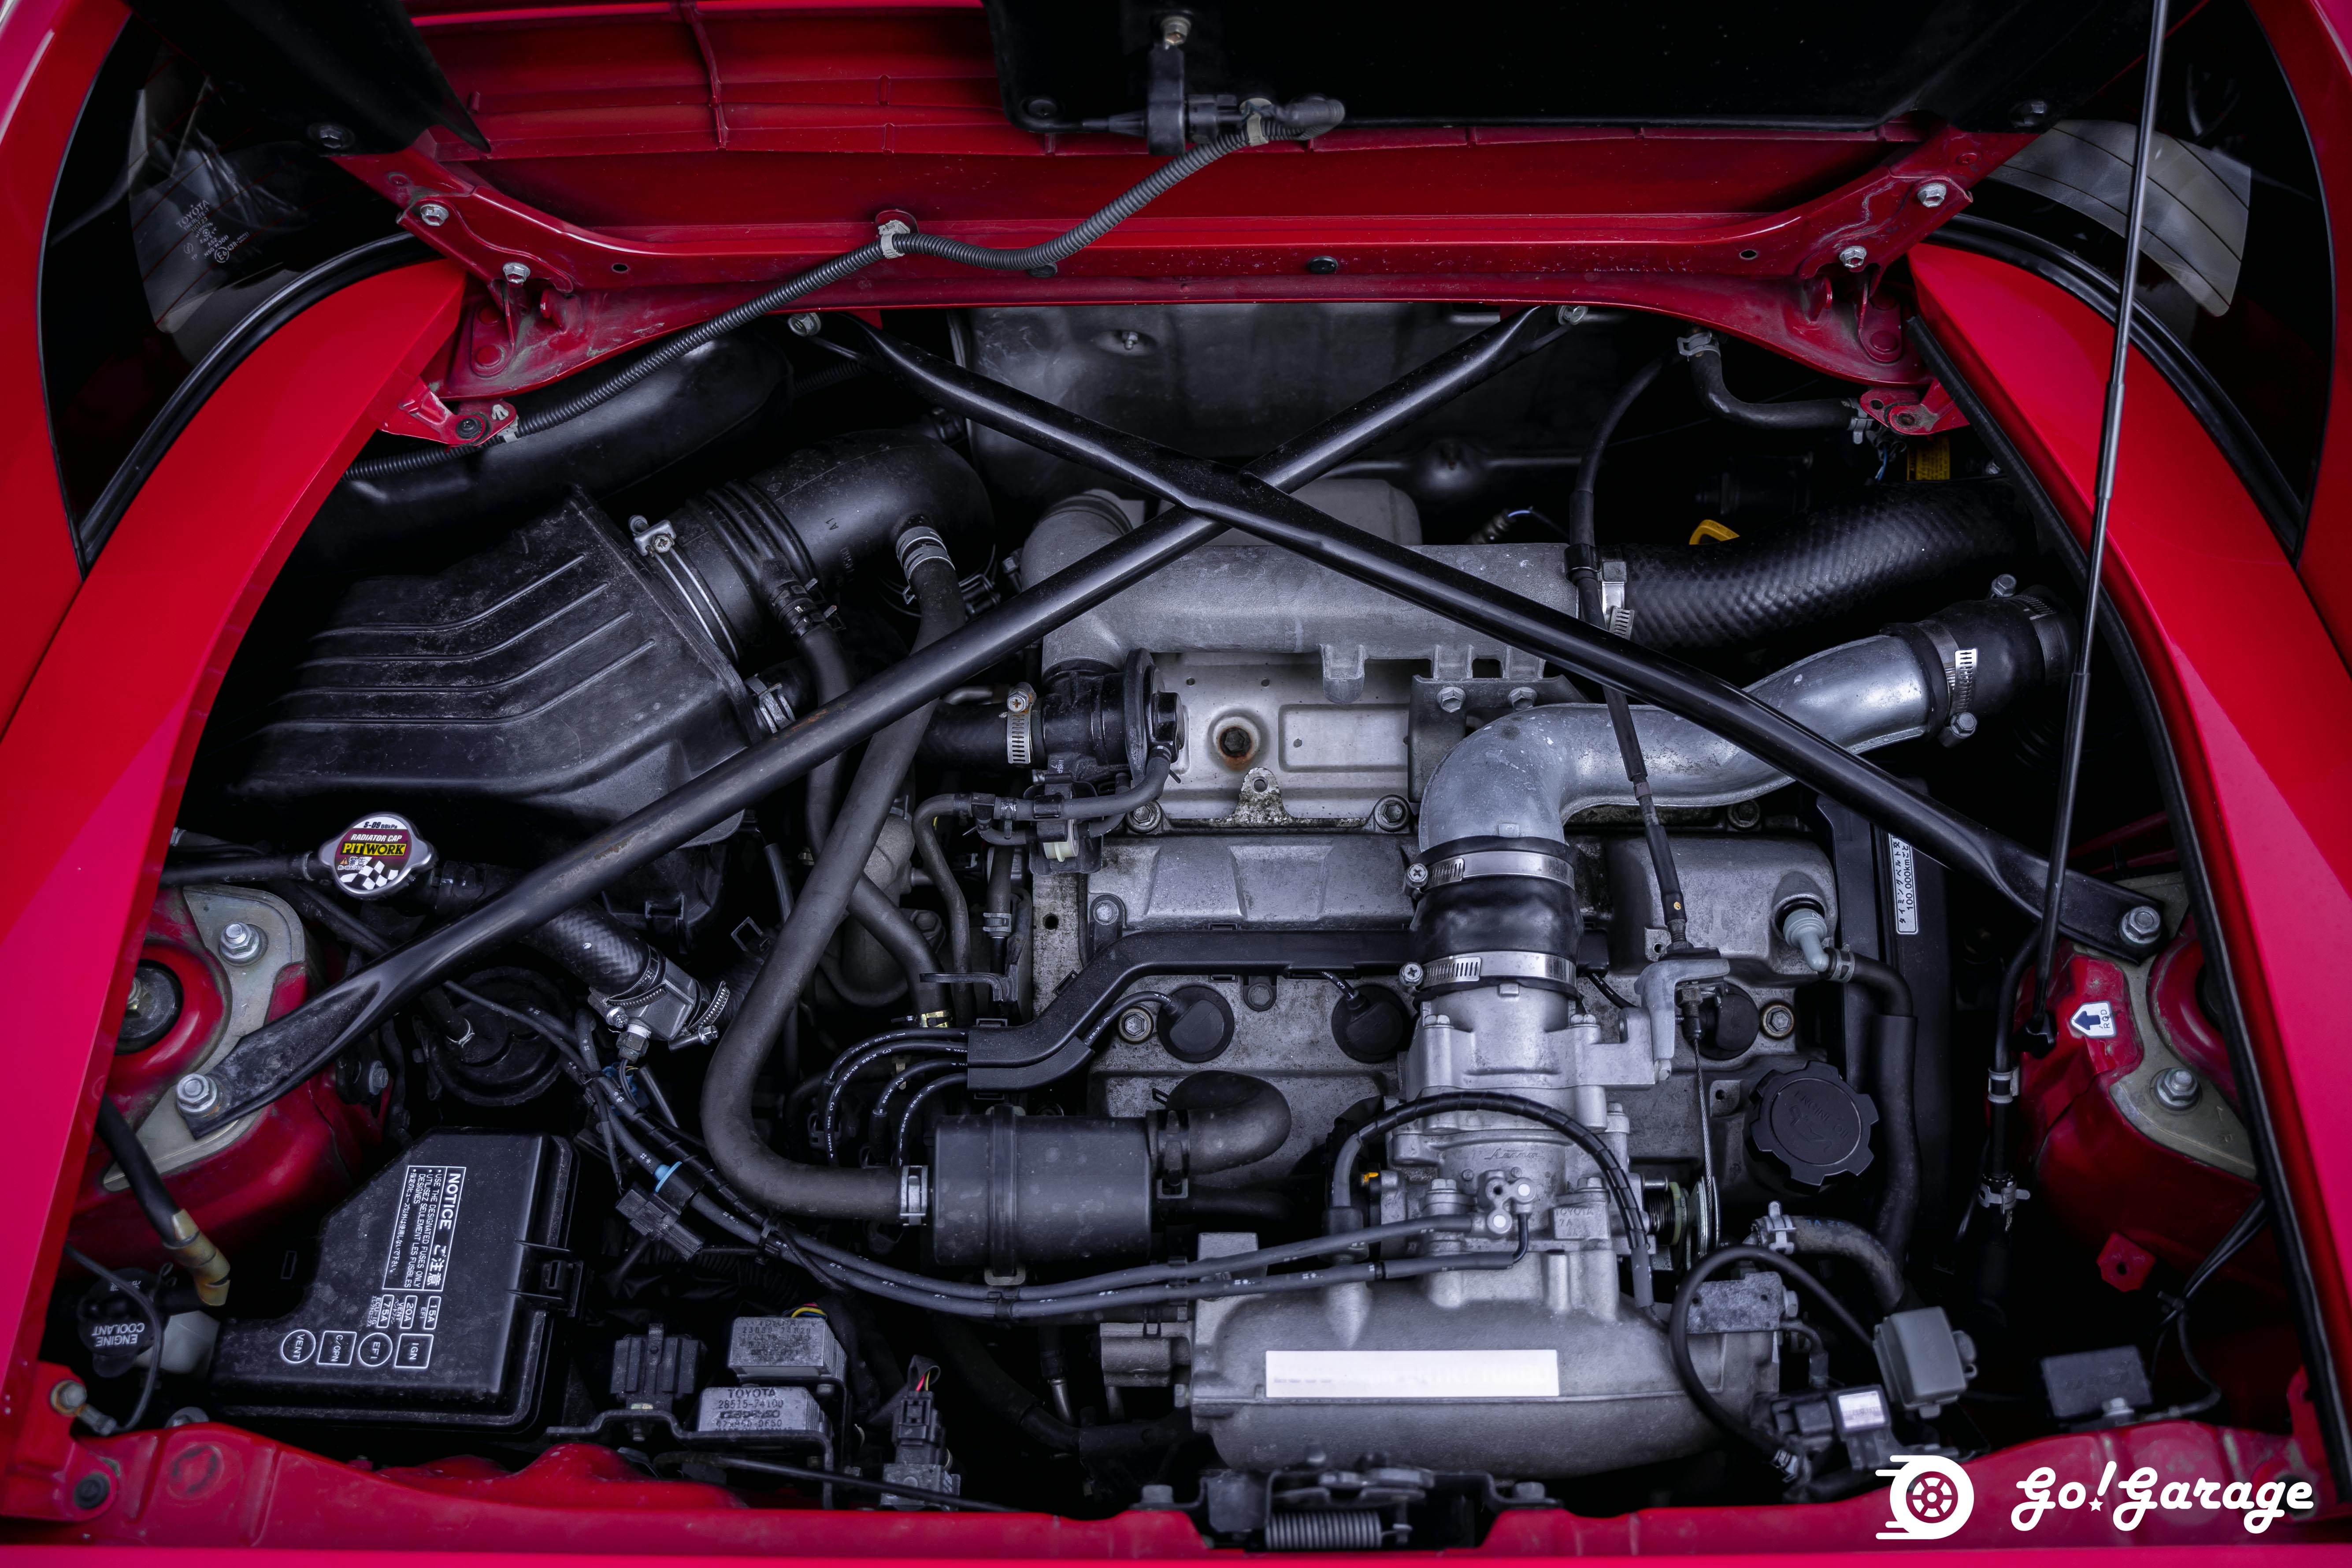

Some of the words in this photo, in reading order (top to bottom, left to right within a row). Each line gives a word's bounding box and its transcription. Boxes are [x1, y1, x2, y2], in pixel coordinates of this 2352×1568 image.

[176, 199, 210, 228] TOYOTA
[351, 834, 387, 842] RADIATOR
[1893, 836, 1906, 924] タイミングベルト交
[413, 1174, 426, 1204] DESIGNES
[422, 1174, 434, 1201] UTILISEZ
[433, 1174, 443, 1187] USE
[430, 1189, 440, 1202] THE
[439, 1173, 461, 1230] NOTICE
[414, 1203, 427, 1241] SEULEMENT
[1555, 1208, 1594, 1216] TOYOTA
[422, 1204, 436, 1244] DESIGNATED
[411, 1242, 420, 1256] LES
[417, 1246, 428, 1268] FUSES
[404, 1257, 417, 1288] FUSIBLES
[427, 1245, 447, 1286] ご注意
[413, 1271, 423, 1288] ONLY
[380, 1301, 392, 1322] 7.5A
[404, 1302, 414, 1322] 20A
[427, 1305, 438, 1323] 15A
[91, 1322, 145, 1337] COOLANT
[94, 1334, 138, 1347] ENGINE
[295, 1334, 306, 1360] VENT
[330, 1334, 343, 1363] C/OPN
[370, 1341, 381, 1360] EFI
[408, 1342, 420, 1360] IGN
[727, 1388, 775, 1398] TOYOTA
